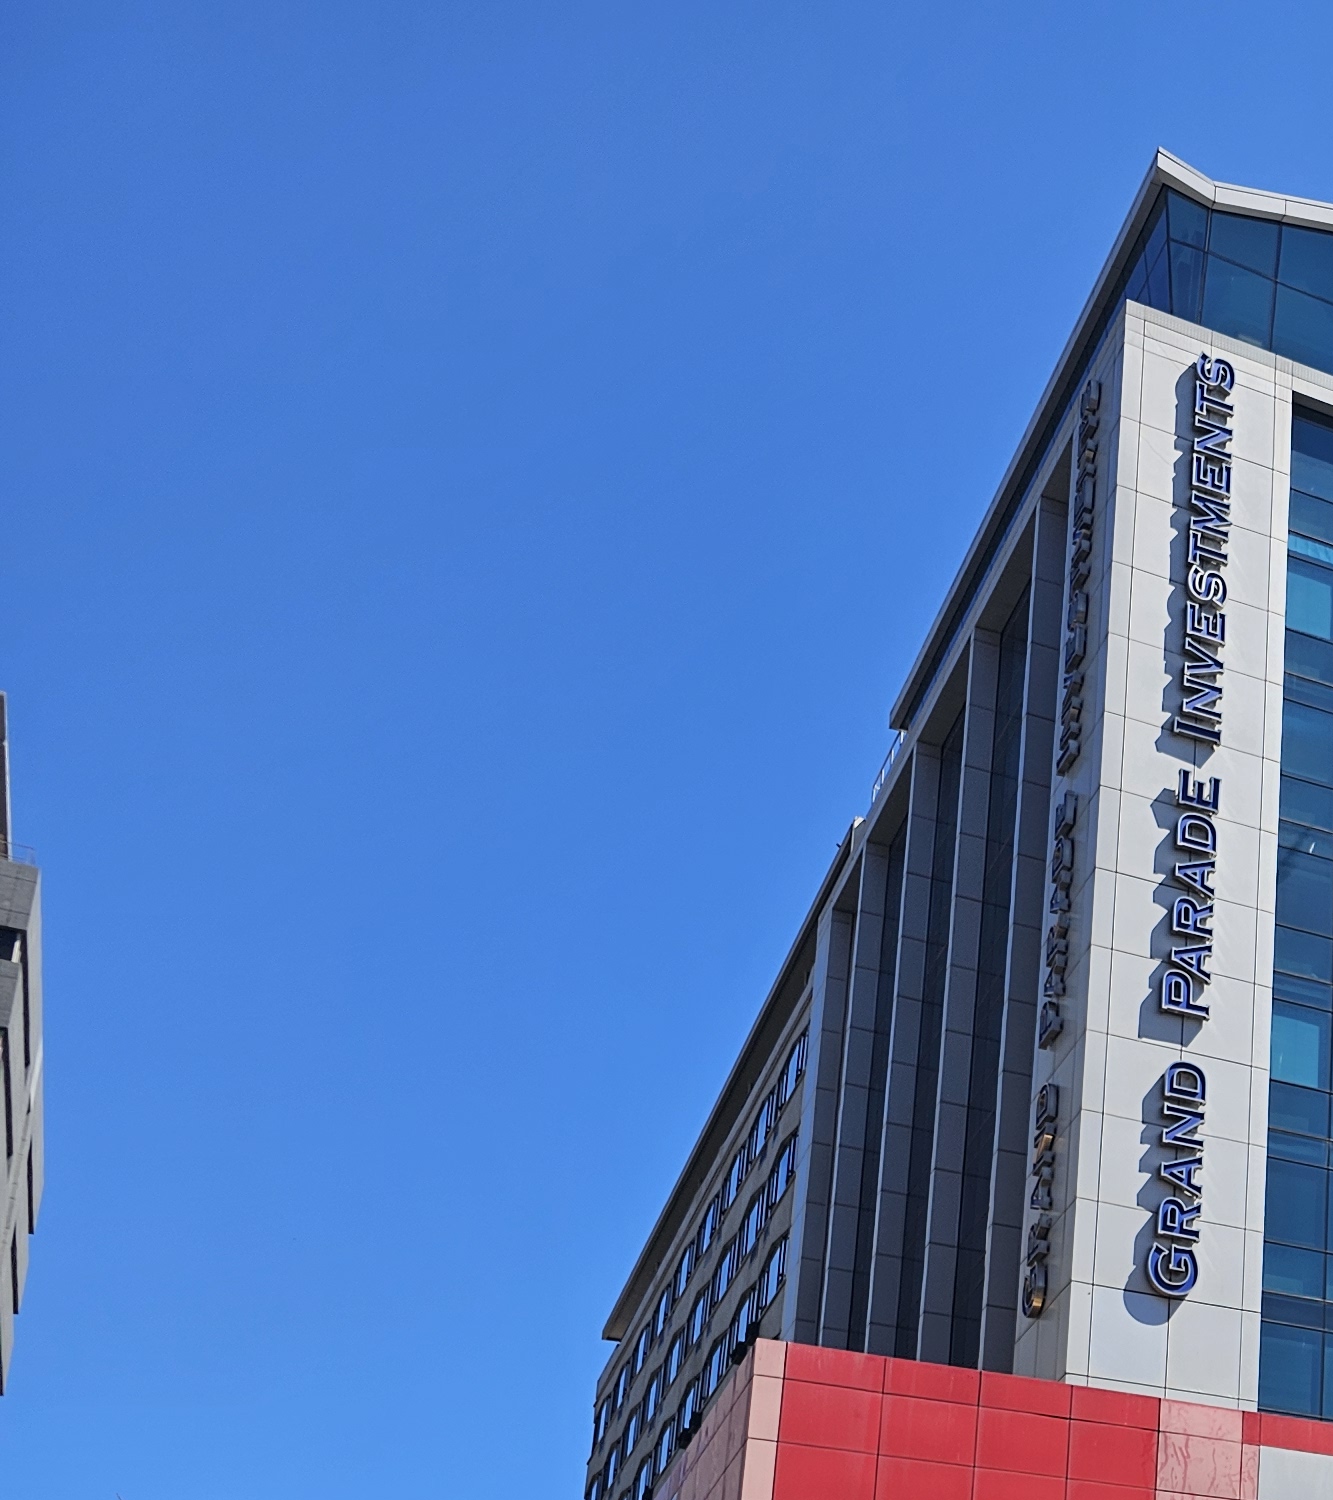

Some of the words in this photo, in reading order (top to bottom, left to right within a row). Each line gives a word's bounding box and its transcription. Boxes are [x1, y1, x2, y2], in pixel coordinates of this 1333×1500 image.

[1173, 350, 1236, 746] INVESTMENTS
[1160, 768, 1223, 1024] PARADE
[1146, 1060, 1209, 1297] GRAND
